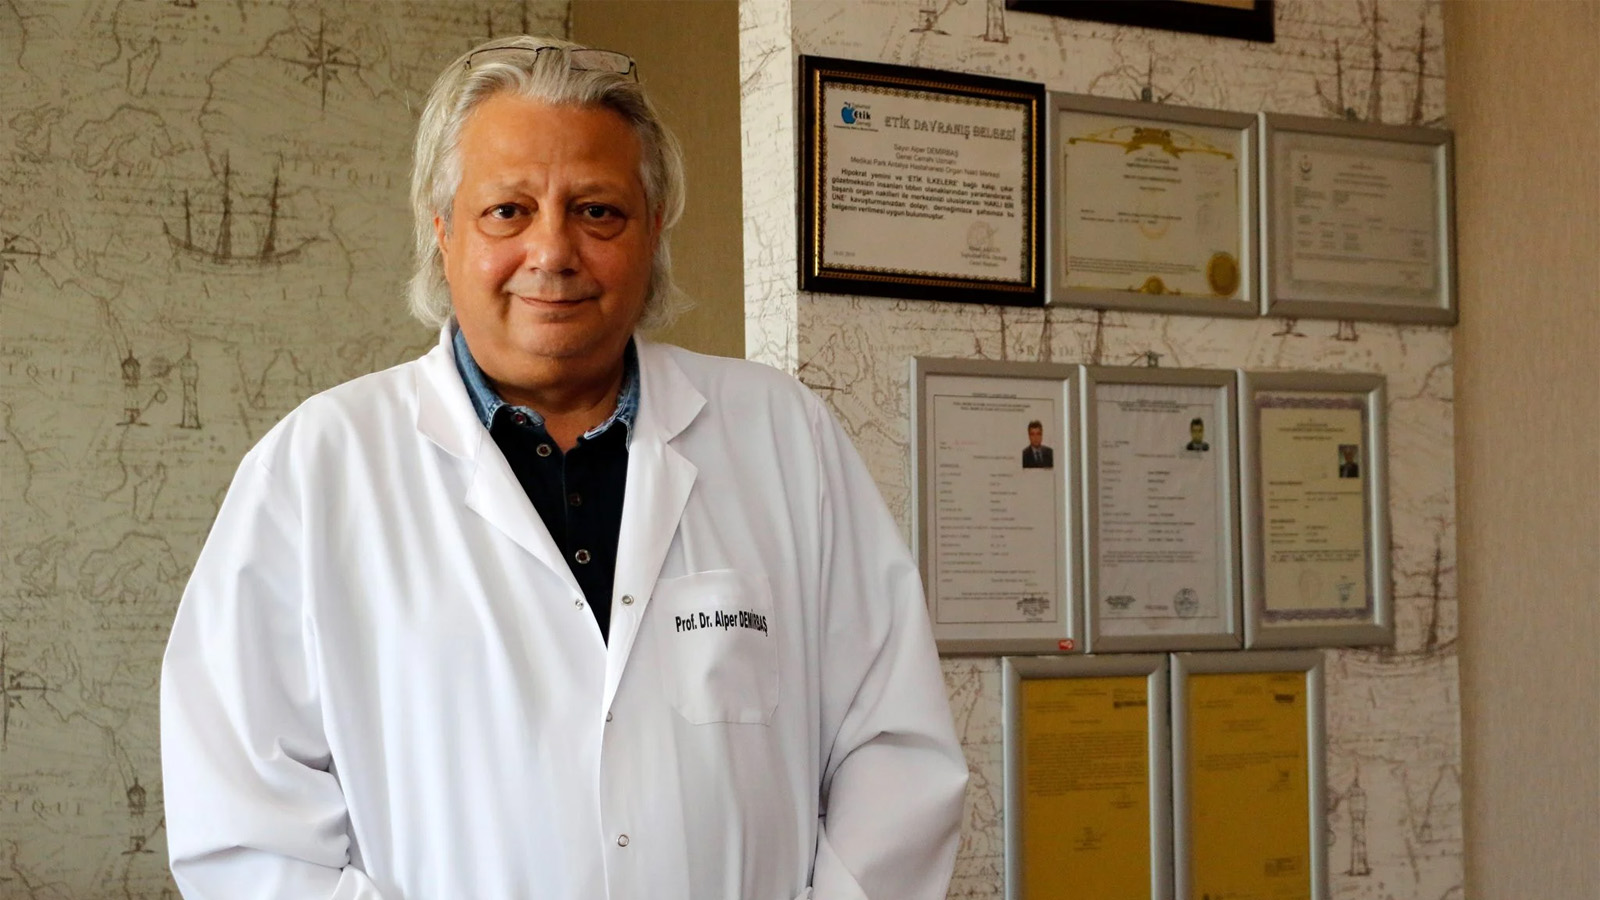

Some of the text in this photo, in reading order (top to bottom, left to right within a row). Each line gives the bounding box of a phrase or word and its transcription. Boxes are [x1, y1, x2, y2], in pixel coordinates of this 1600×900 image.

[854, 110, 871, 120] Etik
[884, 115, 911, 129] ETİK
[914, 119, 970, 140] DAVRANIŞ
[972, 125, 1016, 141] BELGESİ
[841, 168, 867, 177] Hipokrat
[856, 188, 873, 196] organ
[832, 202, 857, 212] belgenin
[859, 206, 885, 214] verilmesi
[675, 613, 697, 632] Prof.
[699, 612, 712, 628] Dr.
[715, 610, 738, 631] Alper
